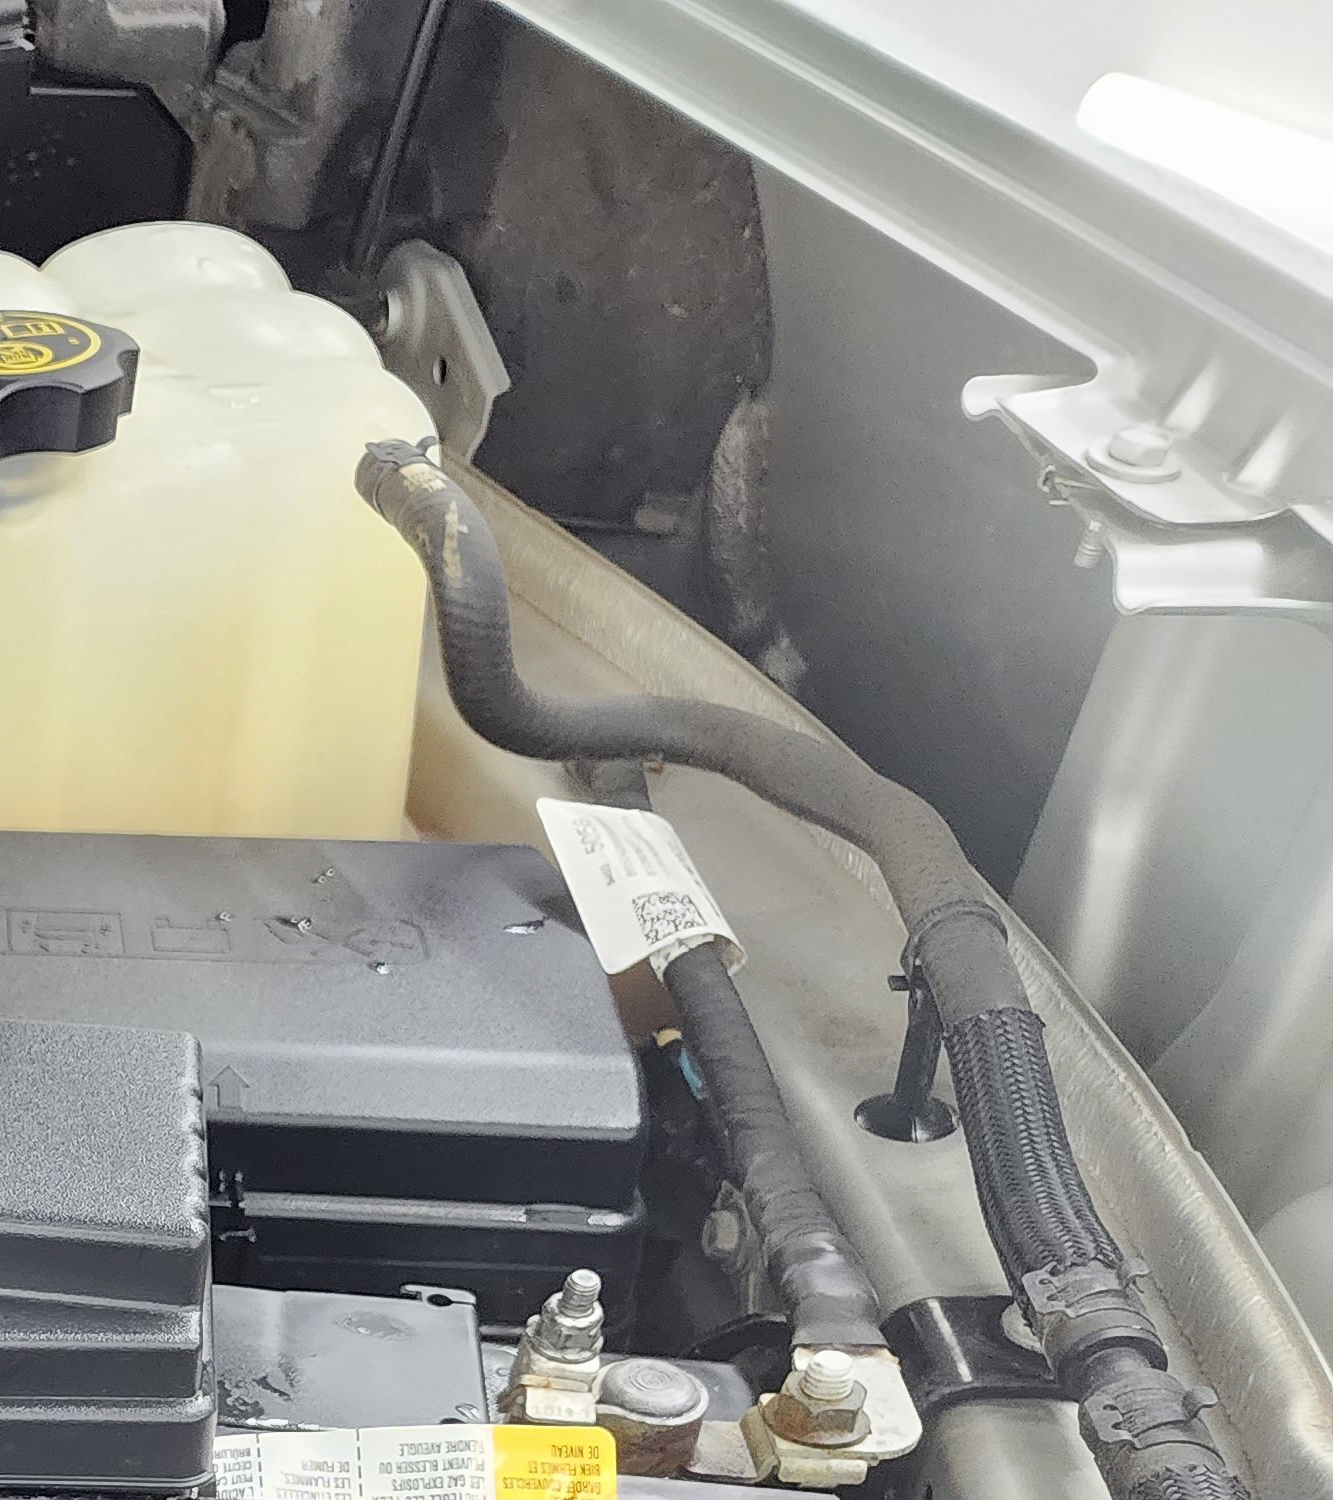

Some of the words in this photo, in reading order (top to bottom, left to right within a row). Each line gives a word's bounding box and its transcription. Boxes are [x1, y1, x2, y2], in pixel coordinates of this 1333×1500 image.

[398, 1442, 441, 1456] AVEUGLE
[589, 1446, 599, 1459] DE
[379, 1462, 392, 1474] OU
[396, 1460, 438, 1473] BLESSER
[391, 1476, 444, 1491] EXPLOSIFS
[447, 1475, 466, 1489] GAZ
[567, 1481, 601, 1496] GARDE
